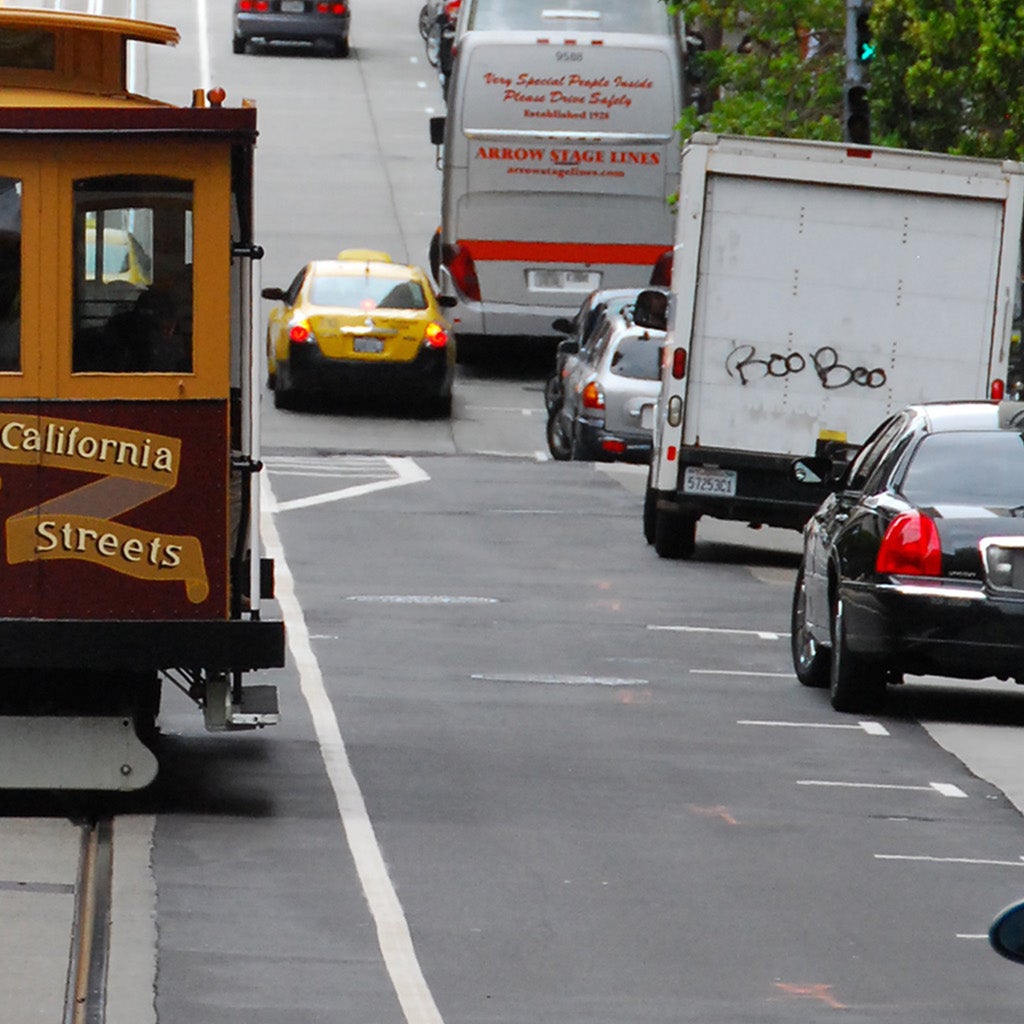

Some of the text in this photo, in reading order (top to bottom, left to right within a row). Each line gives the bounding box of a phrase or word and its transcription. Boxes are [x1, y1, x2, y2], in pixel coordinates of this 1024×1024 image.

[483, 72, 654, 89] Very Special People Inside
[503, 89, 632, 108] Please Drive Safely
[524, 109, 587, 120] Established
[476, 146, 661, 166] ARROW STAGE LINES
[506, 166, 626, 179] arrowstagelines.com
[0, 422, 173, 473] California
[36, 520, 184, 568] Streets
